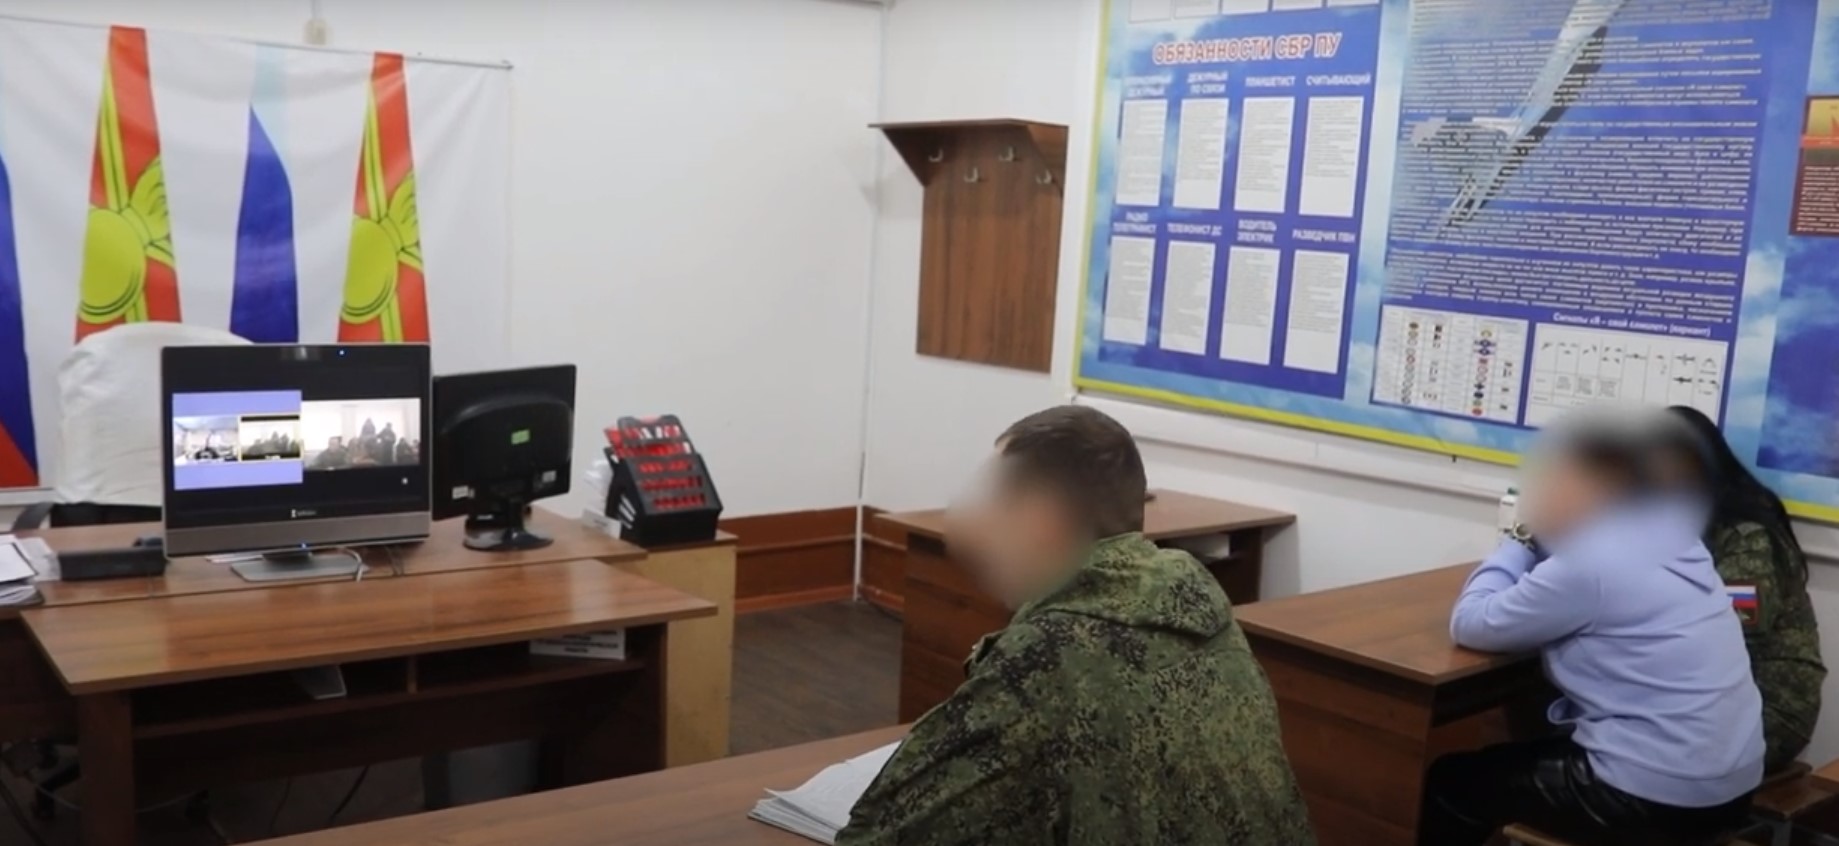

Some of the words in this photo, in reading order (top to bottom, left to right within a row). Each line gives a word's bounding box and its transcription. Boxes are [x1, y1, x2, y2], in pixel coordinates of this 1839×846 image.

[1153, 37, 1272, 65] ОБЯЗАННОСТИ
[1275, 35, 1312, 61] СБР
[1314, 32, 1342, 59] ПУ
[1306, 72, 1371, 87] СЧИТЫВАЮЩИЙ
[1553, 311, 1588, 325] Сигналы
